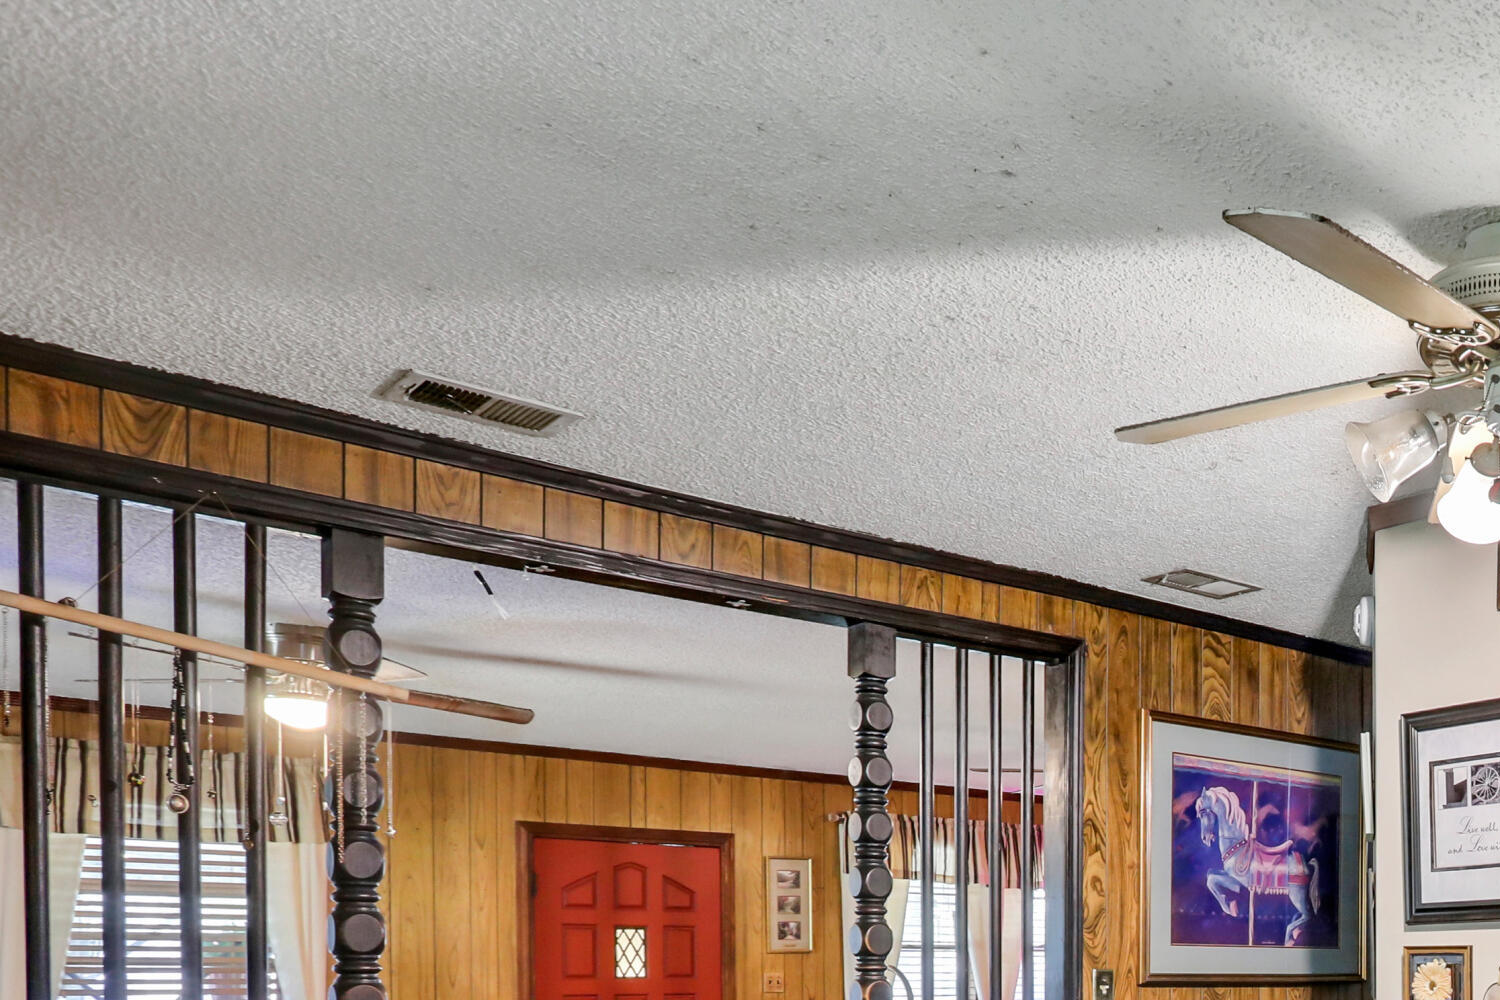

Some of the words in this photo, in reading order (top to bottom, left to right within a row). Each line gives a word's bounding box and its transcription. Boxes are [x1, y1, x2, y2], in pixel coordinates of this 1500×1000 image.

[1457, 815, 1479, 835] Live
[1447, 845, 1464, 855] and
[1467, 834, 1488, 853] Love
